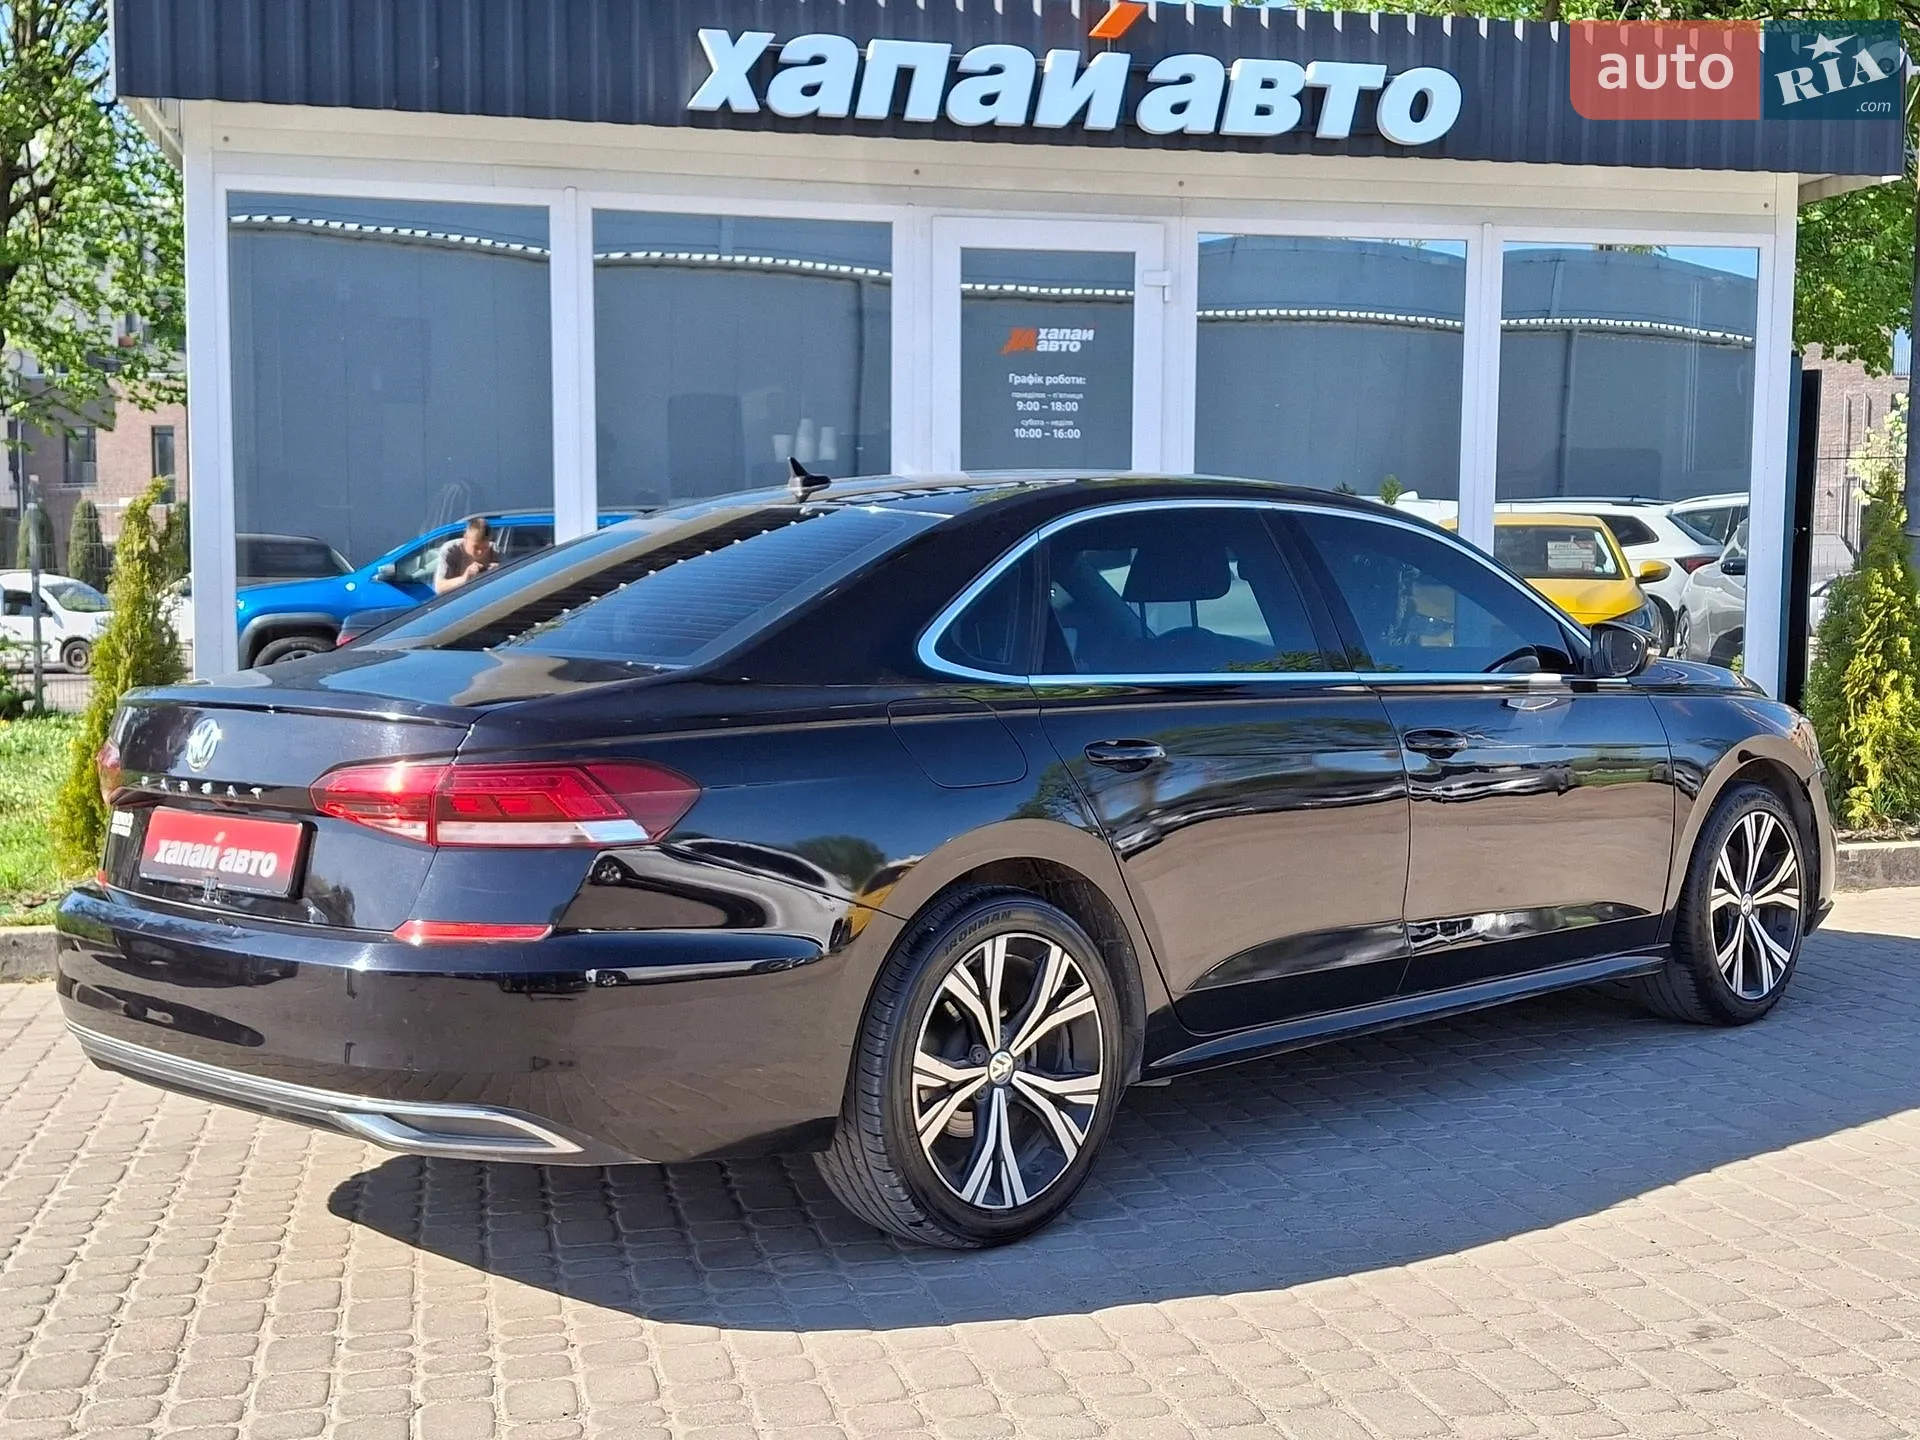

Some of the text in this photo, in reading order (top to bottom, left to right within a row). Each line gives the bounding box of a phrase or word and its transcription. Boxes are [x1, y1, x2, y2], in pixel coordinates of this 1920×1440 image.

[686, 2, 1463, 147] хапай авто
[1036, 340, 1082, 352] авто
[1008, 372, 1044, 386] Графік
[1016, 401, 1040, 411] 9:00
[1050, 401, 1079, 412] 18:00
[1013, 428, 1042, 438] 10:00
[1052, 428, 1081, 439] 16:00
[154, 831, 278, 878] хапай авто
